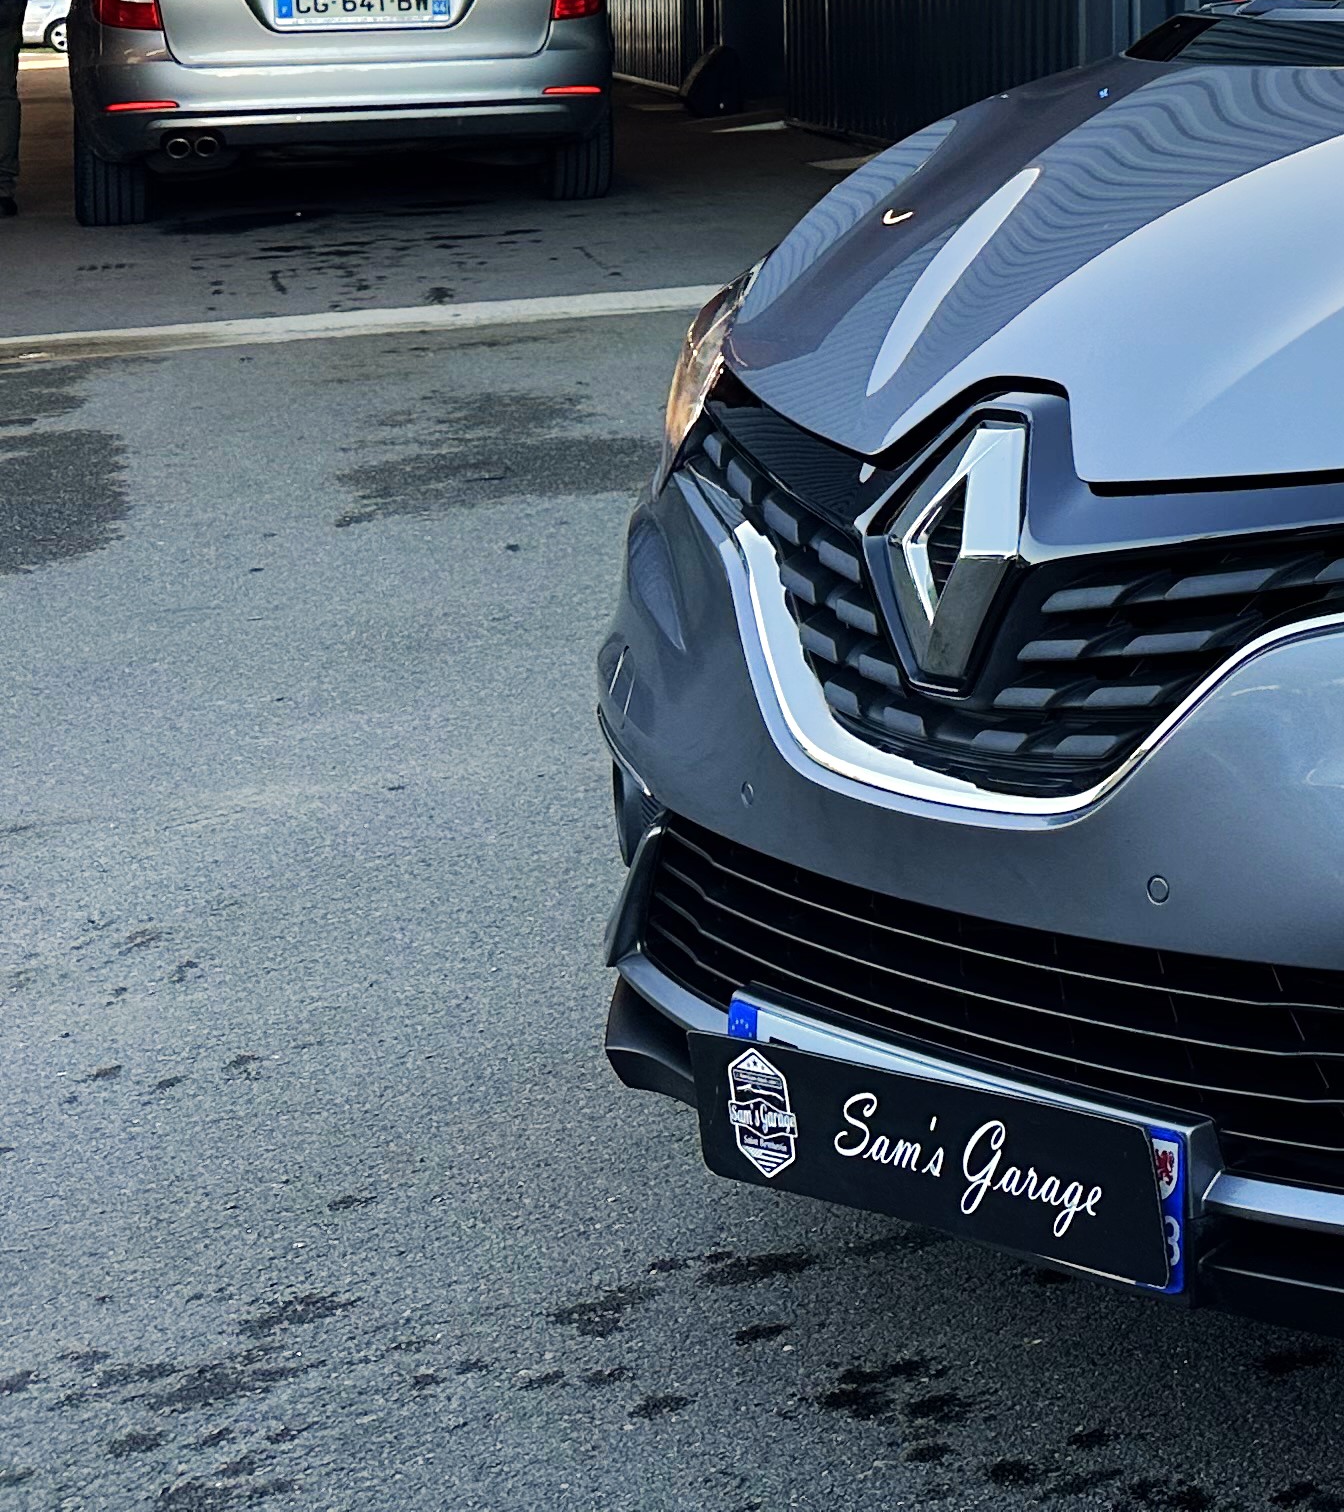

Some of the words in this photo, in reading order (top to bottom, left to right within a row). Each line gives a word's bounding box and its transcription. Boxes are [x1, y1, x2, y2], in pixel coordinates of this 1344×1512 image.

[731, 1102, 761, 1128] Sam's
[759, 1103, 797, 1133] Garage
[833, 1091, 944, 1177] Sam's
[960, 1119, 1103, 1238] Garage
